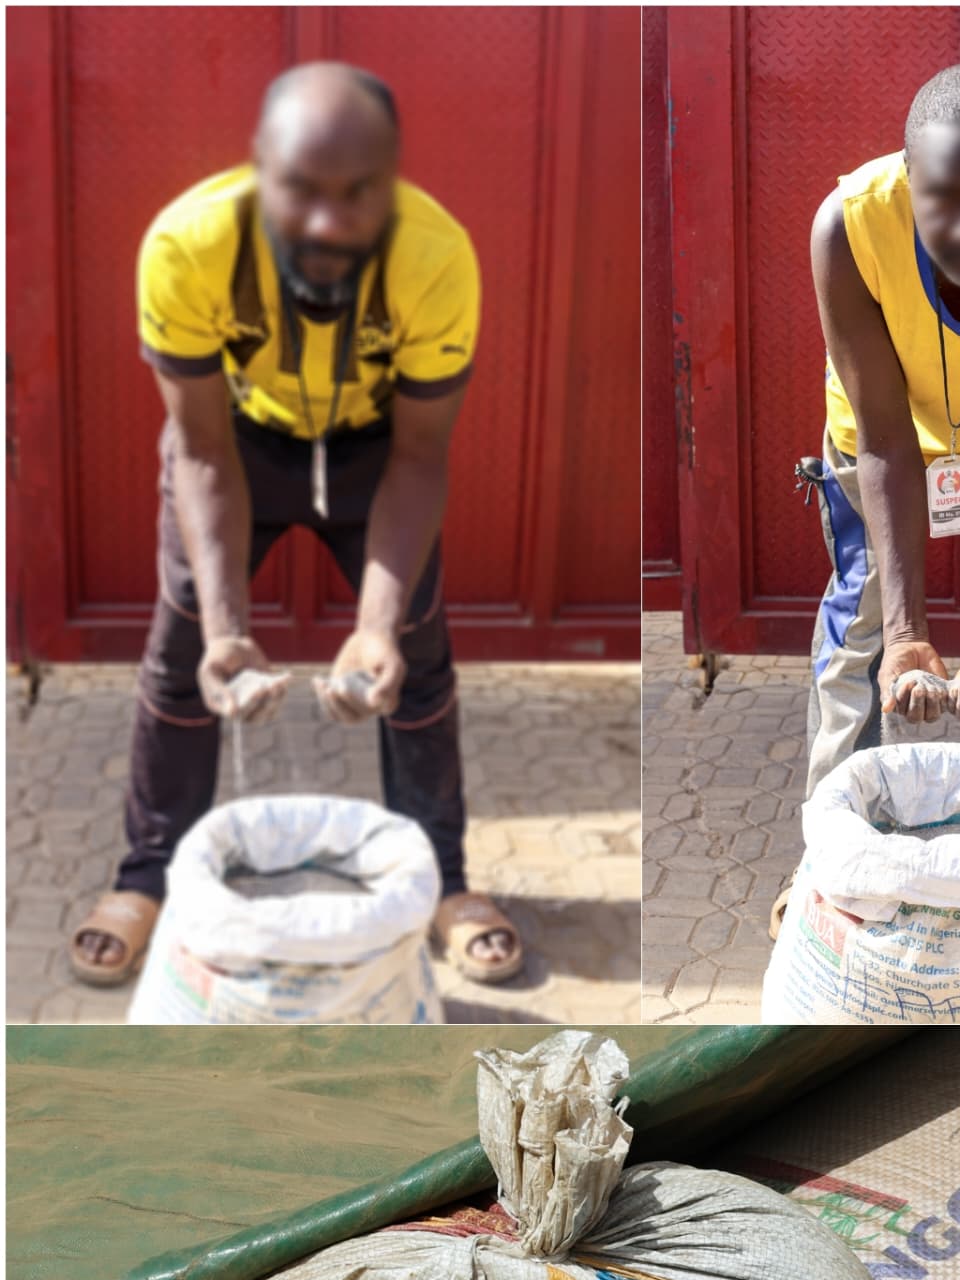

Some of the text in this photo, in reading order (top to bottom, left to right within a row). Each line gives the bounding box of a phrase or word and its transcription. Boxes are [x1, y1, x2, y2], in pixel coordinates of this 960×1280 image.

[925, 942, 945, 954] PLC
[910, 962, 960, 976] Address:
[886, 968, 950, 991] Churchgate
